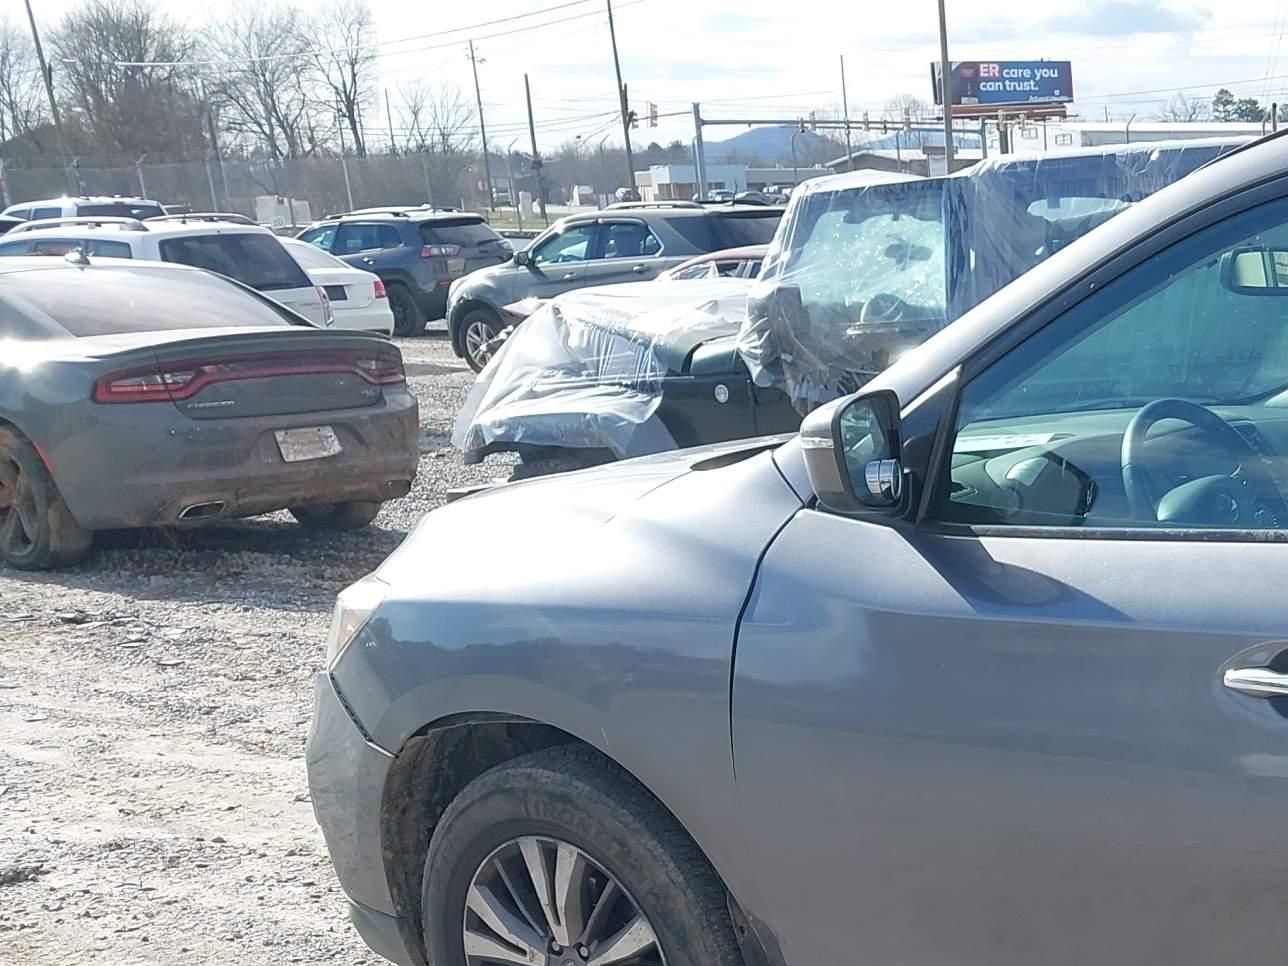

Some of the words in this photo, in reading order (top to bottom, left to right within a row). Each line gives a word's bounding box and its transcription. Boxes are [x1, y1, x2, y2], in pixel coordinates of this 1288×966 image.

[979, 63, 1000, 78] ER
[1002, 68, 1032, 78] care
[1034, 67, 1059, 80] you
[979, 80, 1003, 91] can
[1004, 78, 1040, 91] trust.
